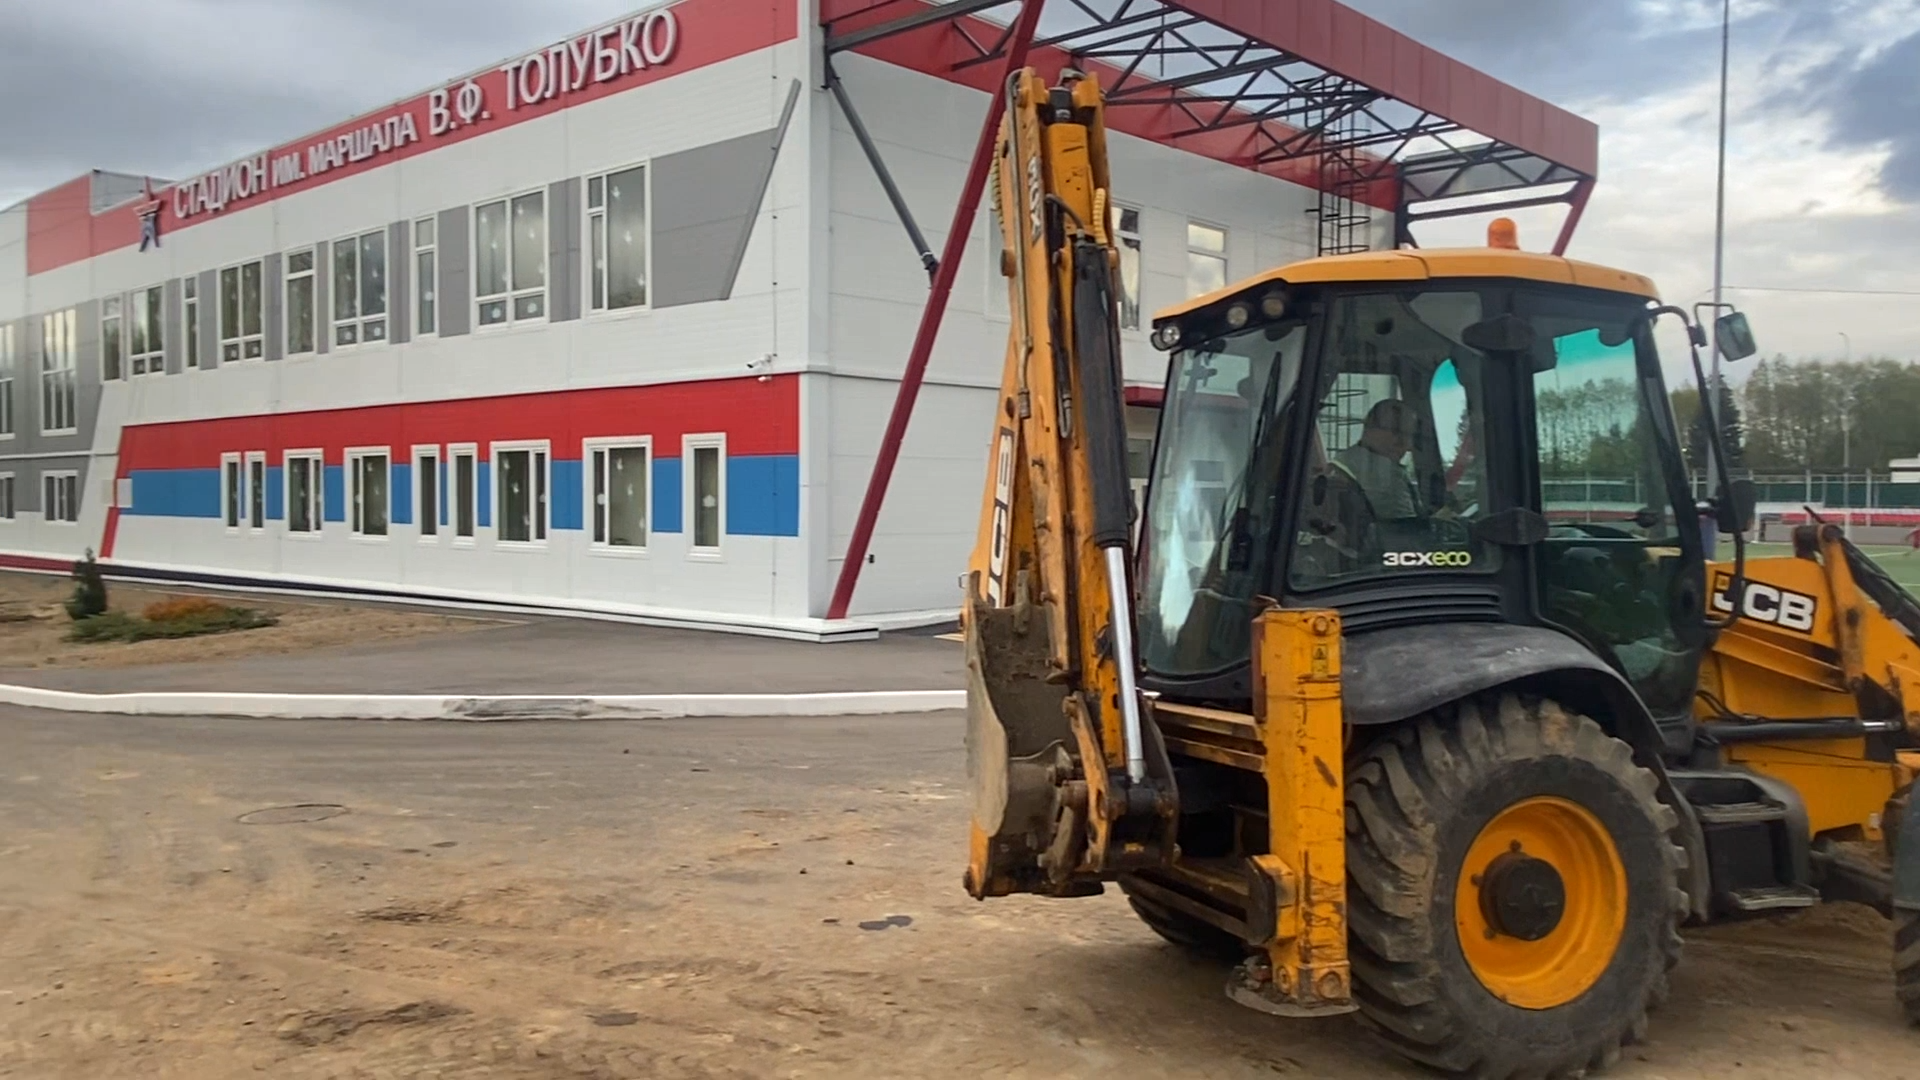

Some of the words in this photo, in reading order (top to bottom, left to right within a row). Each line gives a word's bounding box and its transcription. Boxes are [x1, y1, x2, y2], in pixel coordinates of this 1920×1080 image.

[174, 154, 268, 219] СТАДИОН
[272, 152, 306, 187] ИМ.
[308, 112, 418, 176] МАРШАЛА
[429, 79, 491, 136] В.Ф.
[501, 8, 678, 110] ТОЛУБКО
[1382, 551, 1472, 566] 3CXeco
